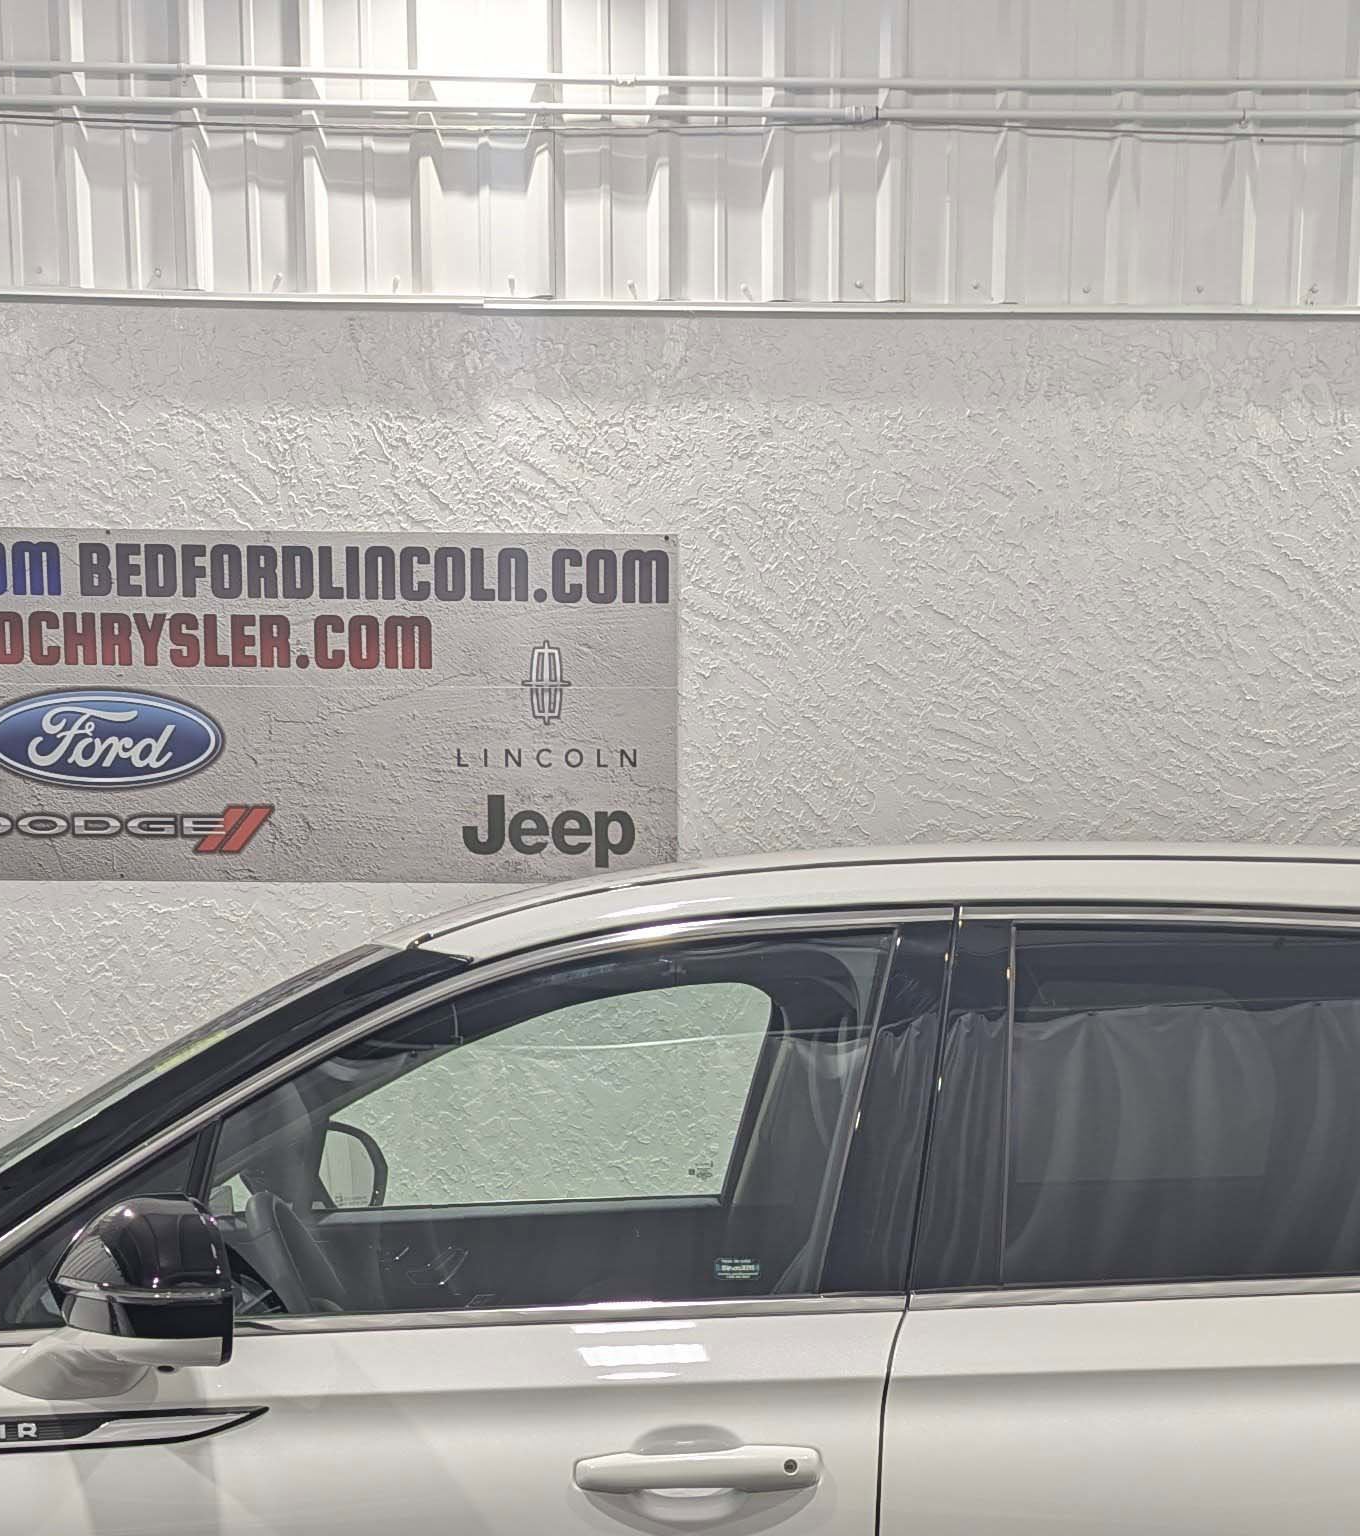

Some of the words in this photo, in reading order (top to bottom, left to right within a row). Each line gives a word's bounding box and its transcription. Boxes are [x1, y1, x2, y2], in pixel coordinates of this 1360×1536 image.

[79, 542, 671, 605] BEDFORDLINCOLN.COM
[27, 705, 177, 768] Ford
[456, 748, 638, 769] LINCOLN
[462, 794, 637, 869] Jeep
